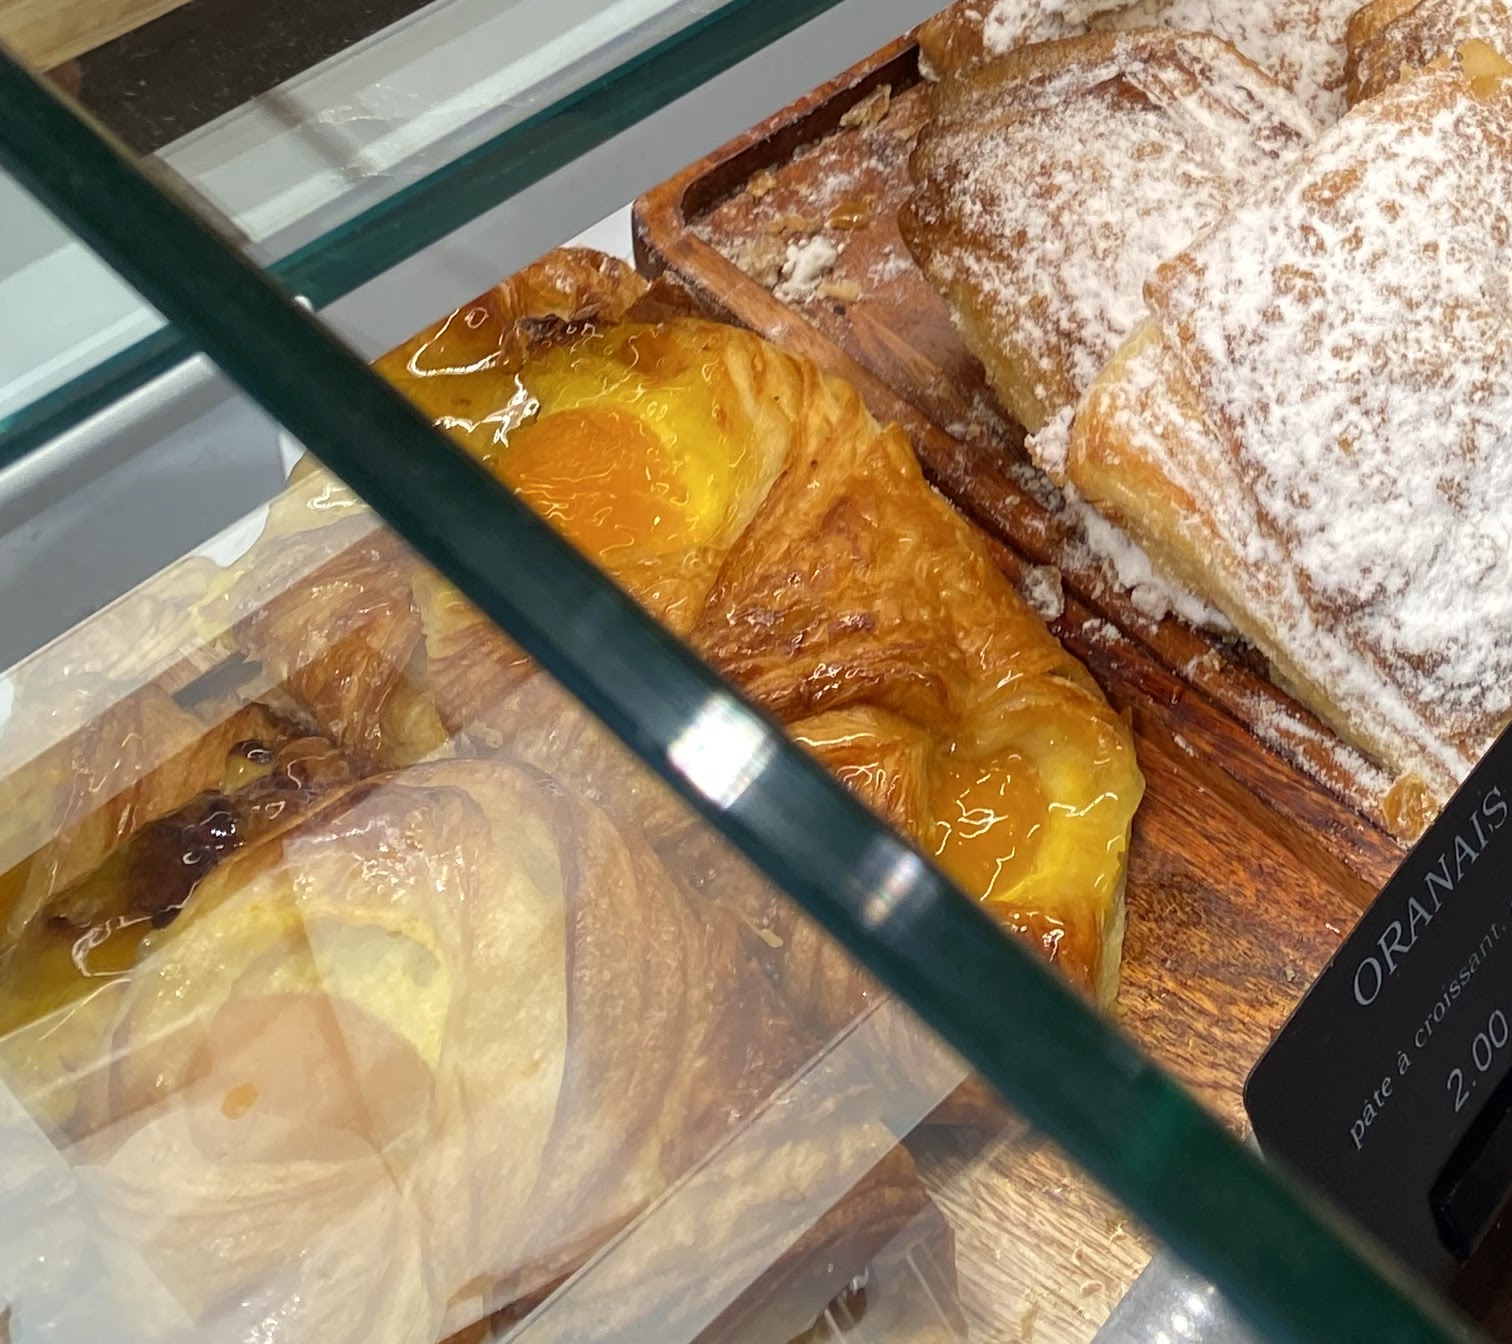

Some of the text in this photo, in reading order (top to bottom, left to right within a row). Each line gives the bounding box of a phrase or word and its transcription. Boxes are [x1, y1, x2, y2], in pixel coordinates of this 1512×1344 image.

[1352, 784, 1512, 1009] ORANAIS
[1349, 1075, 1393, 1151] pâte
[1397, 1048, 1413, 1076] à
[1446, 1008, 1512, 1115] 2.00
